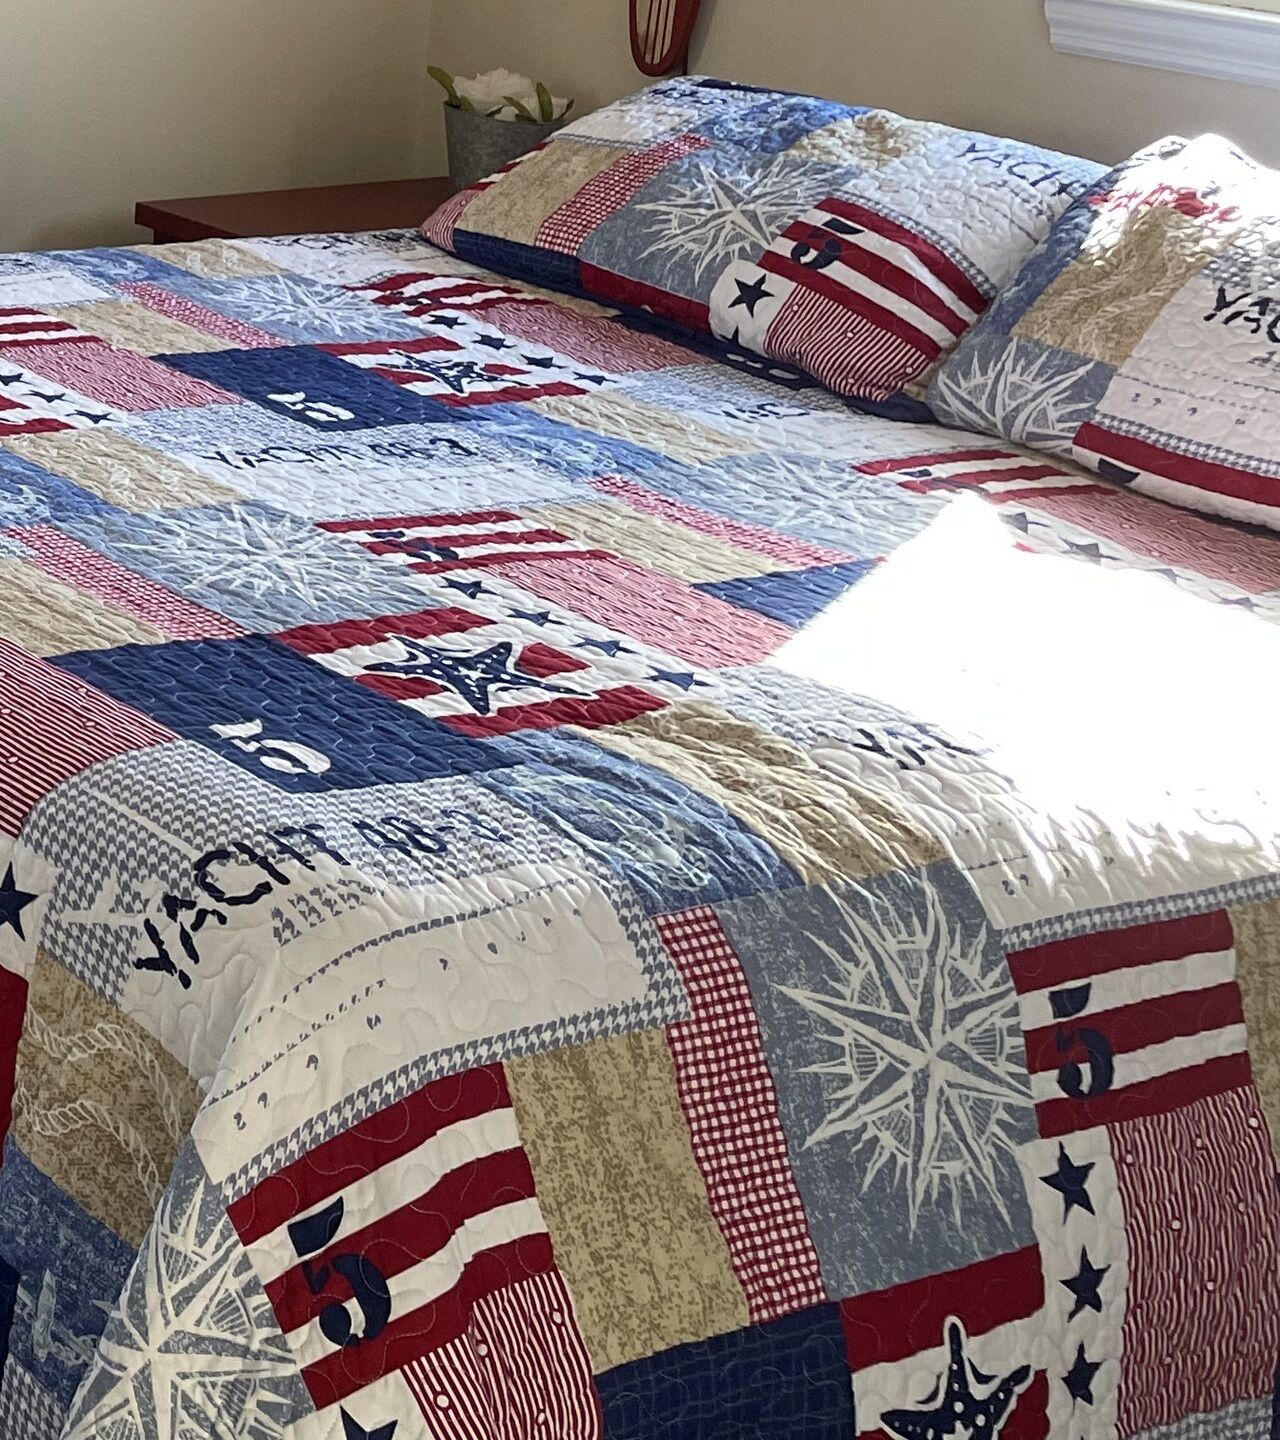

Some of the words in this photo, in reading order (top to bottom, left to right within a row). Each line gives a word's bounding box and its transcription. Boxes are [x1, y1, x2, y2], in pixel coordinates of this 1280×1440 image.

[133, 823, 351, 990] YACHT
[1048, 980, 1115, 1100] 5
[286, 1195, 393, 1348] 5
